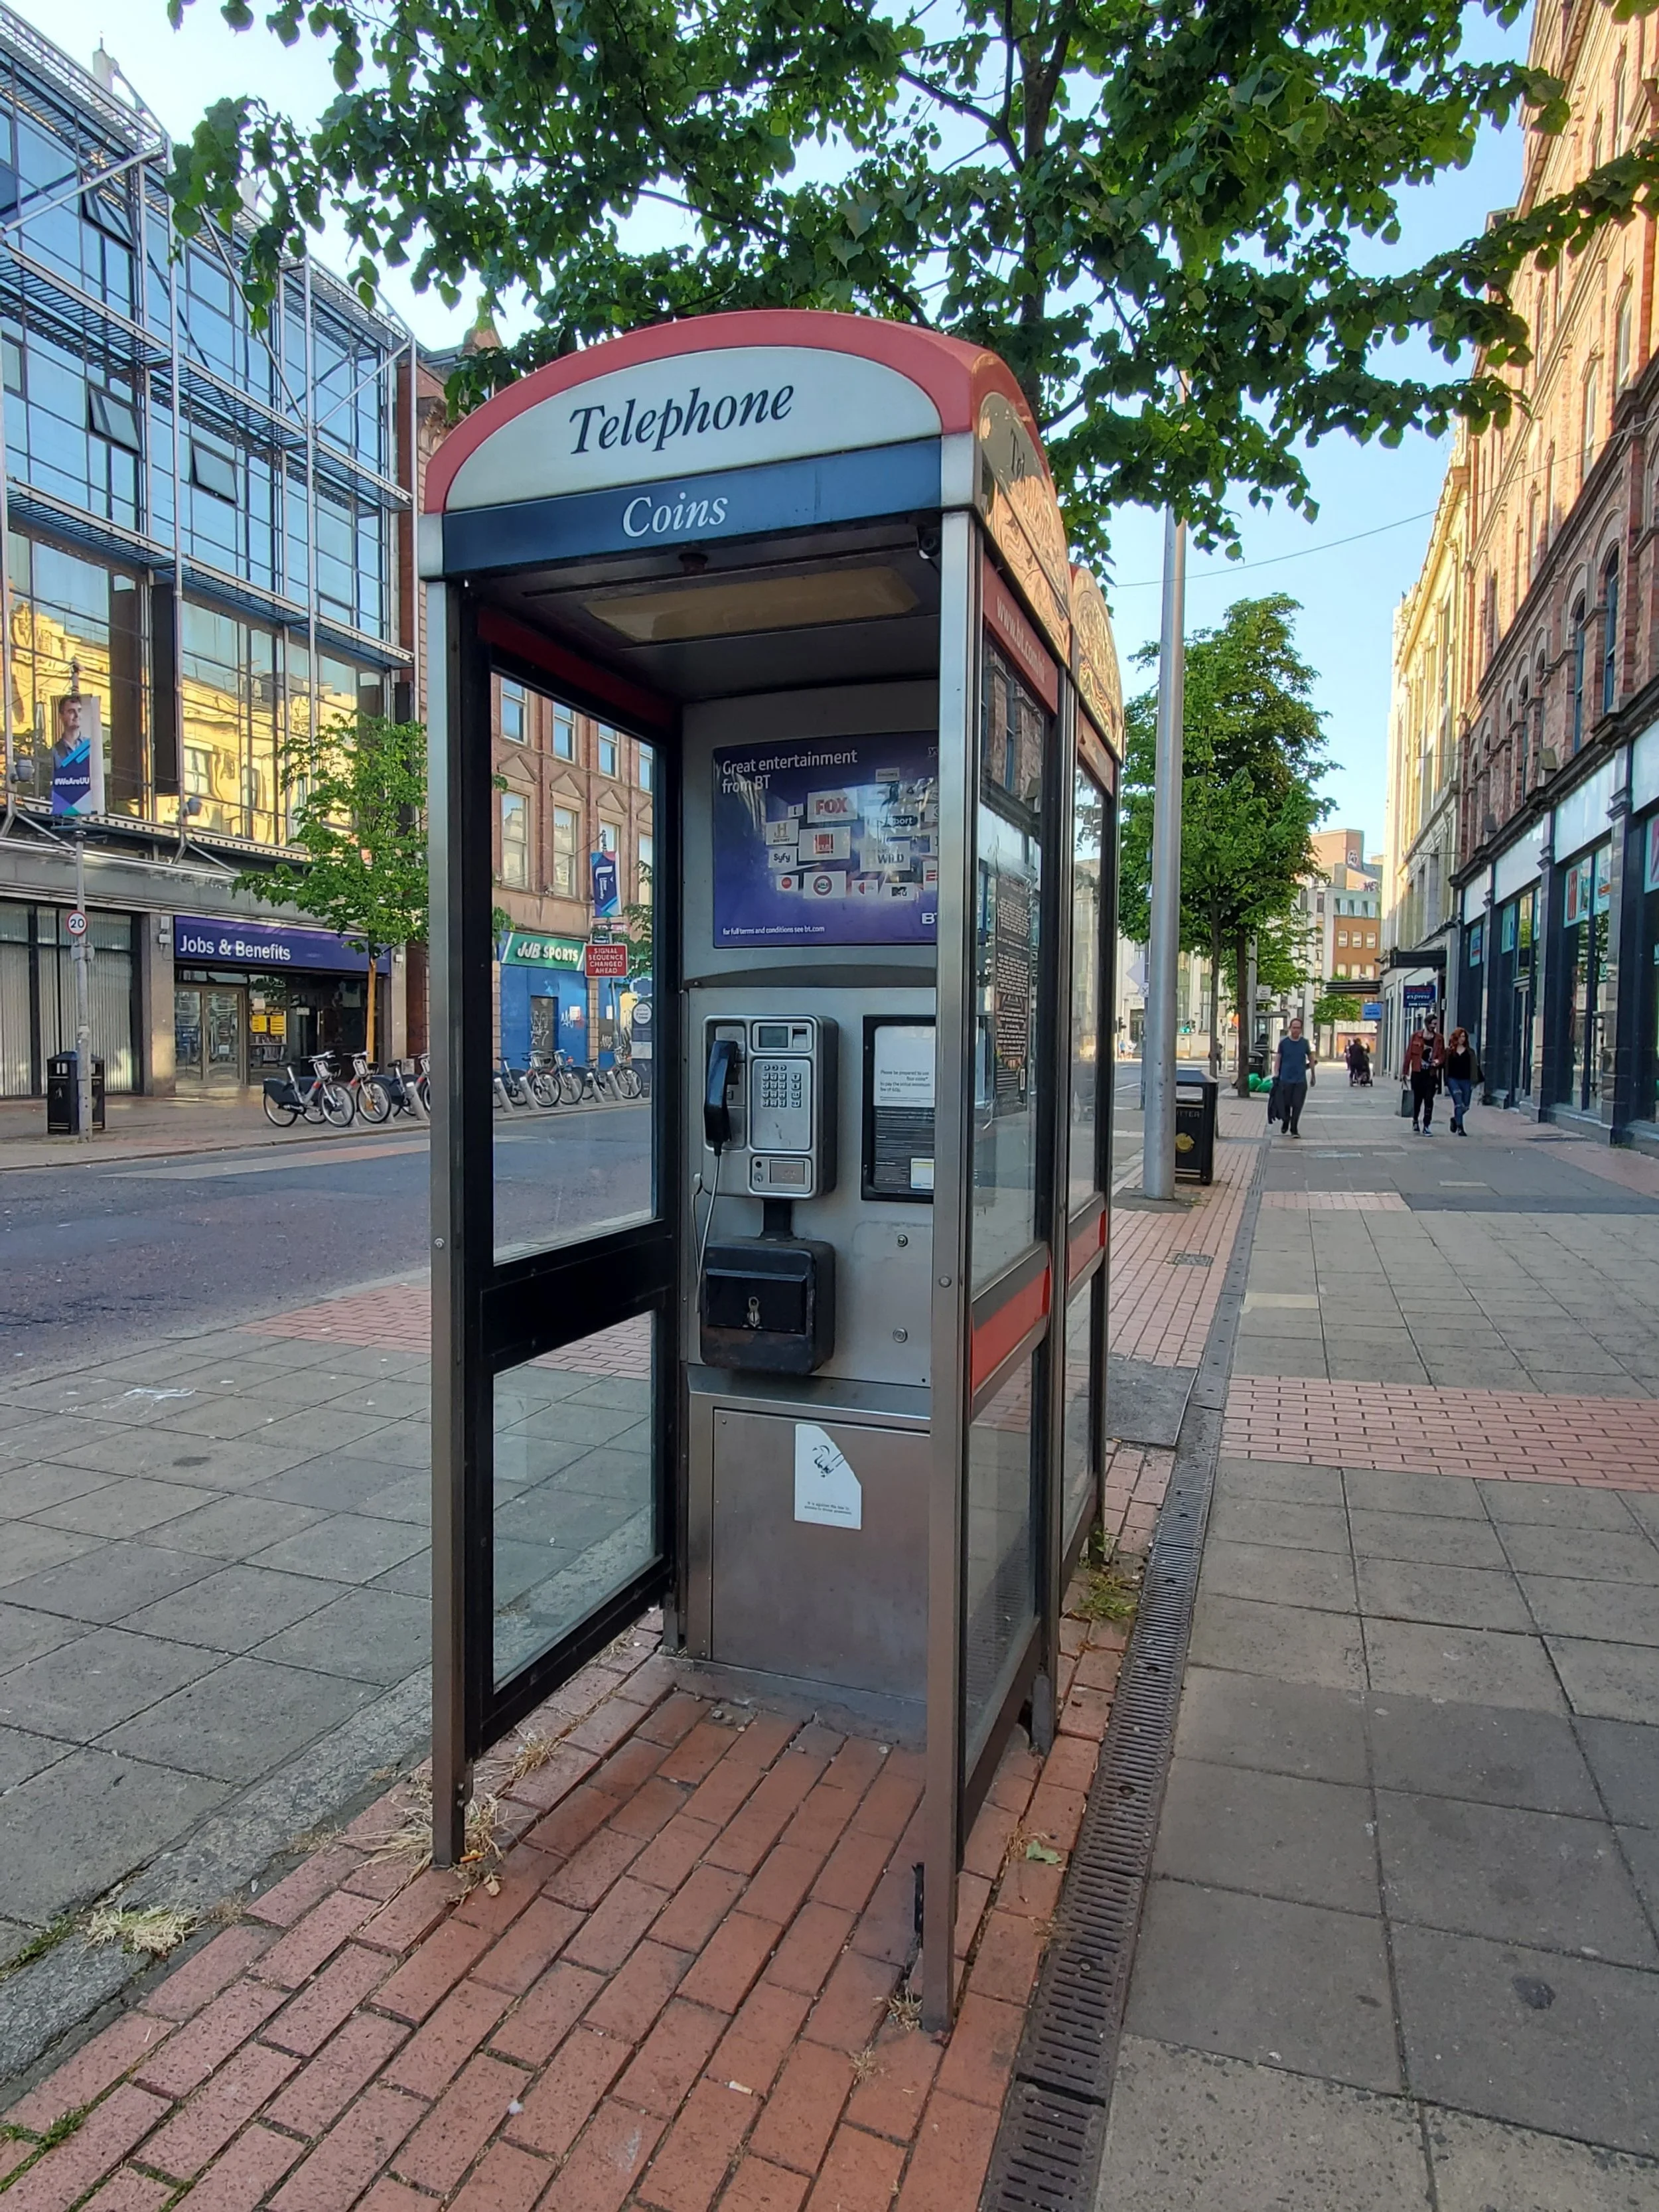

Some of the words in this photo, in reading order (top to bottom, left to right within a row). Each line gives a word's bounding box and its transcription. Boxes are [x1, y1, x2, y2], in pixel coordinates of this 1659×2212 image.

[569, 385, 794, 455] Telephone
[622, 492, 728, 538] Coins
[722, 759, 757, 775] Great
[758, 749, 858, 771] entertainment
[721, 778, 751, 794] from
[755, 774, 770, 790] BT
[815, 798, 847, 815] FOX
[774, 853, 791, 863] Syfy
[70, 919, 85, 928] 20
[922, 912, 938, 924] B
[766, 925, 794, 934] conditions
[180, 935, 214, 954] Jobs
[218, 938, 232, 956] &
[235, 940, 291, 960] Benefits
[518, 942, 541, 959] JJB
[543, 945, 579, 962] SPORTS
